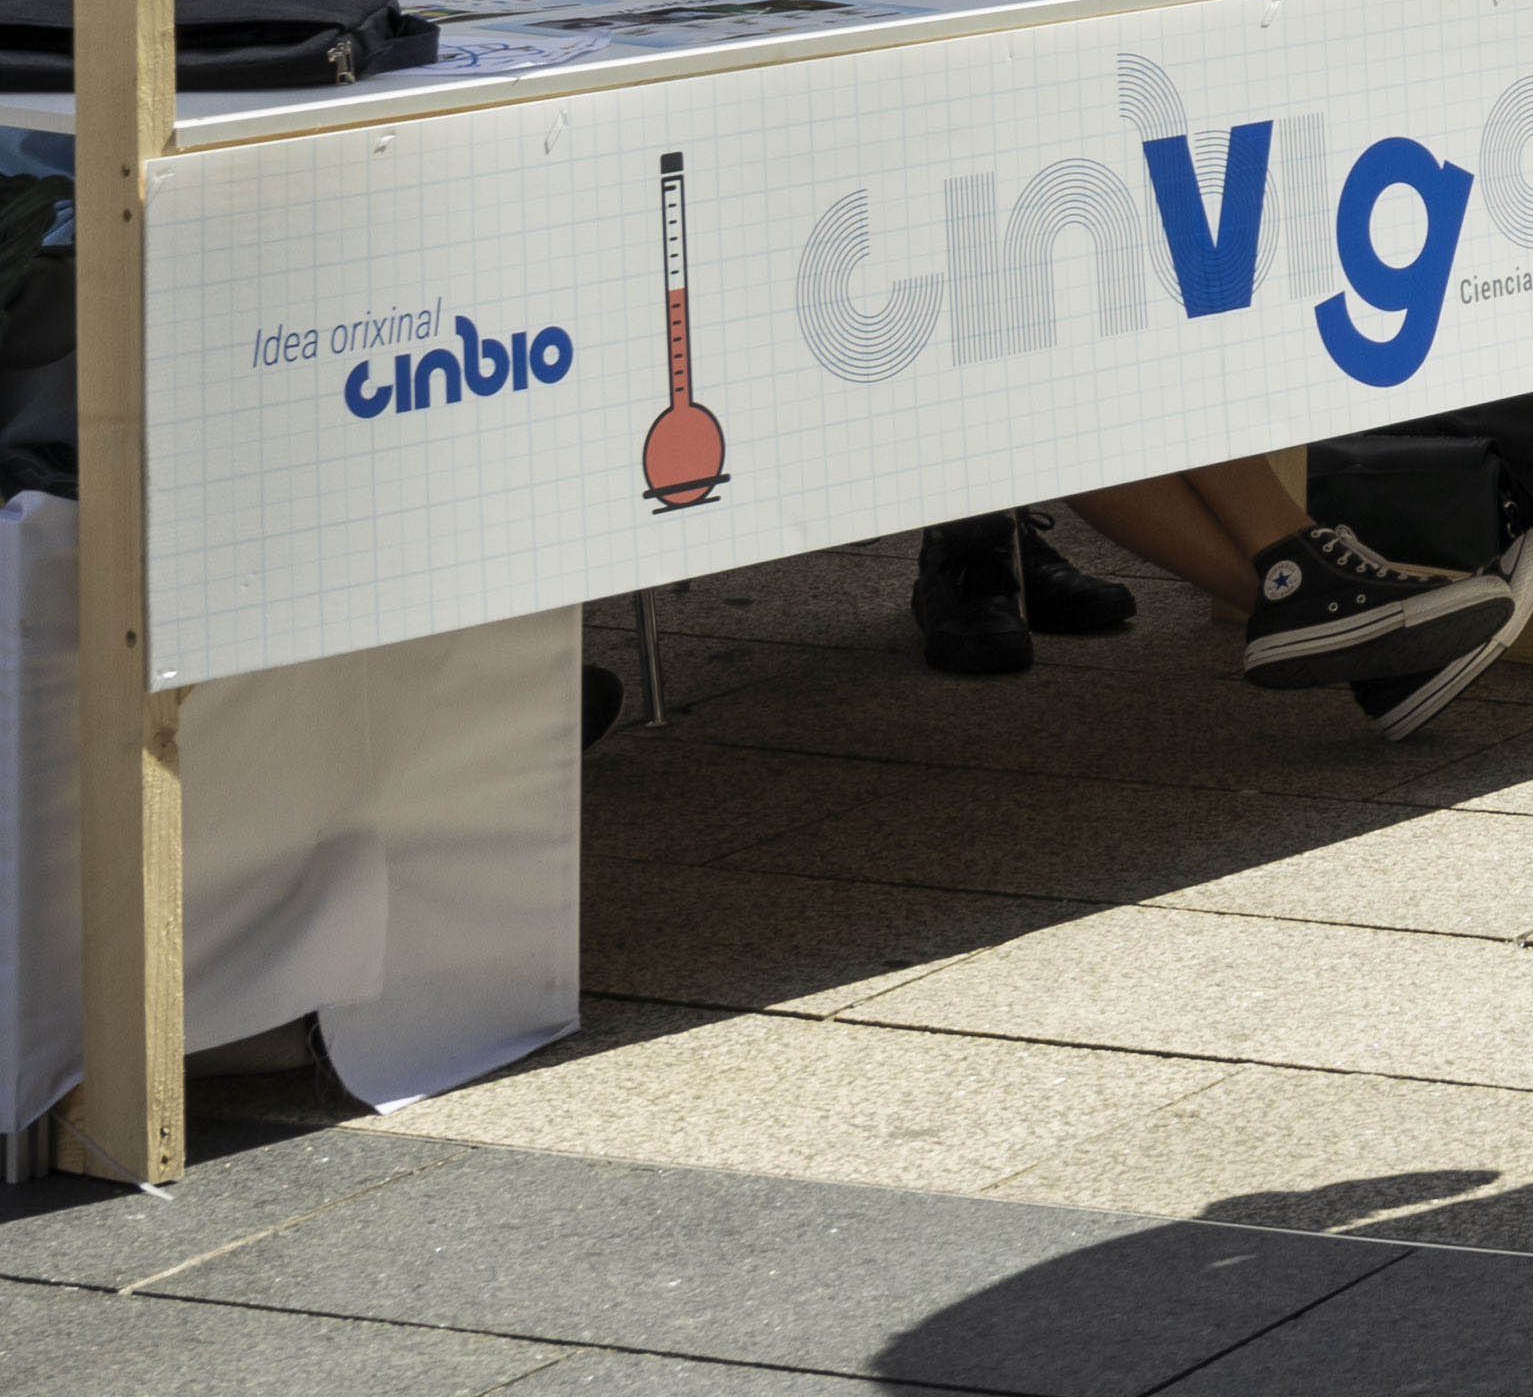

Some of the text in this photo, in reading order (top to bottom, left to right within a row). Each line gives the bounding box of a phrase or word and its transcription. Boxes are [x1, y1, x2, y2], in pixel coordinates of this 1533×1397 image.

[1460, 267, 1533, 304] Ciencia
[253, 296, 441, 368] Idea orixinal
